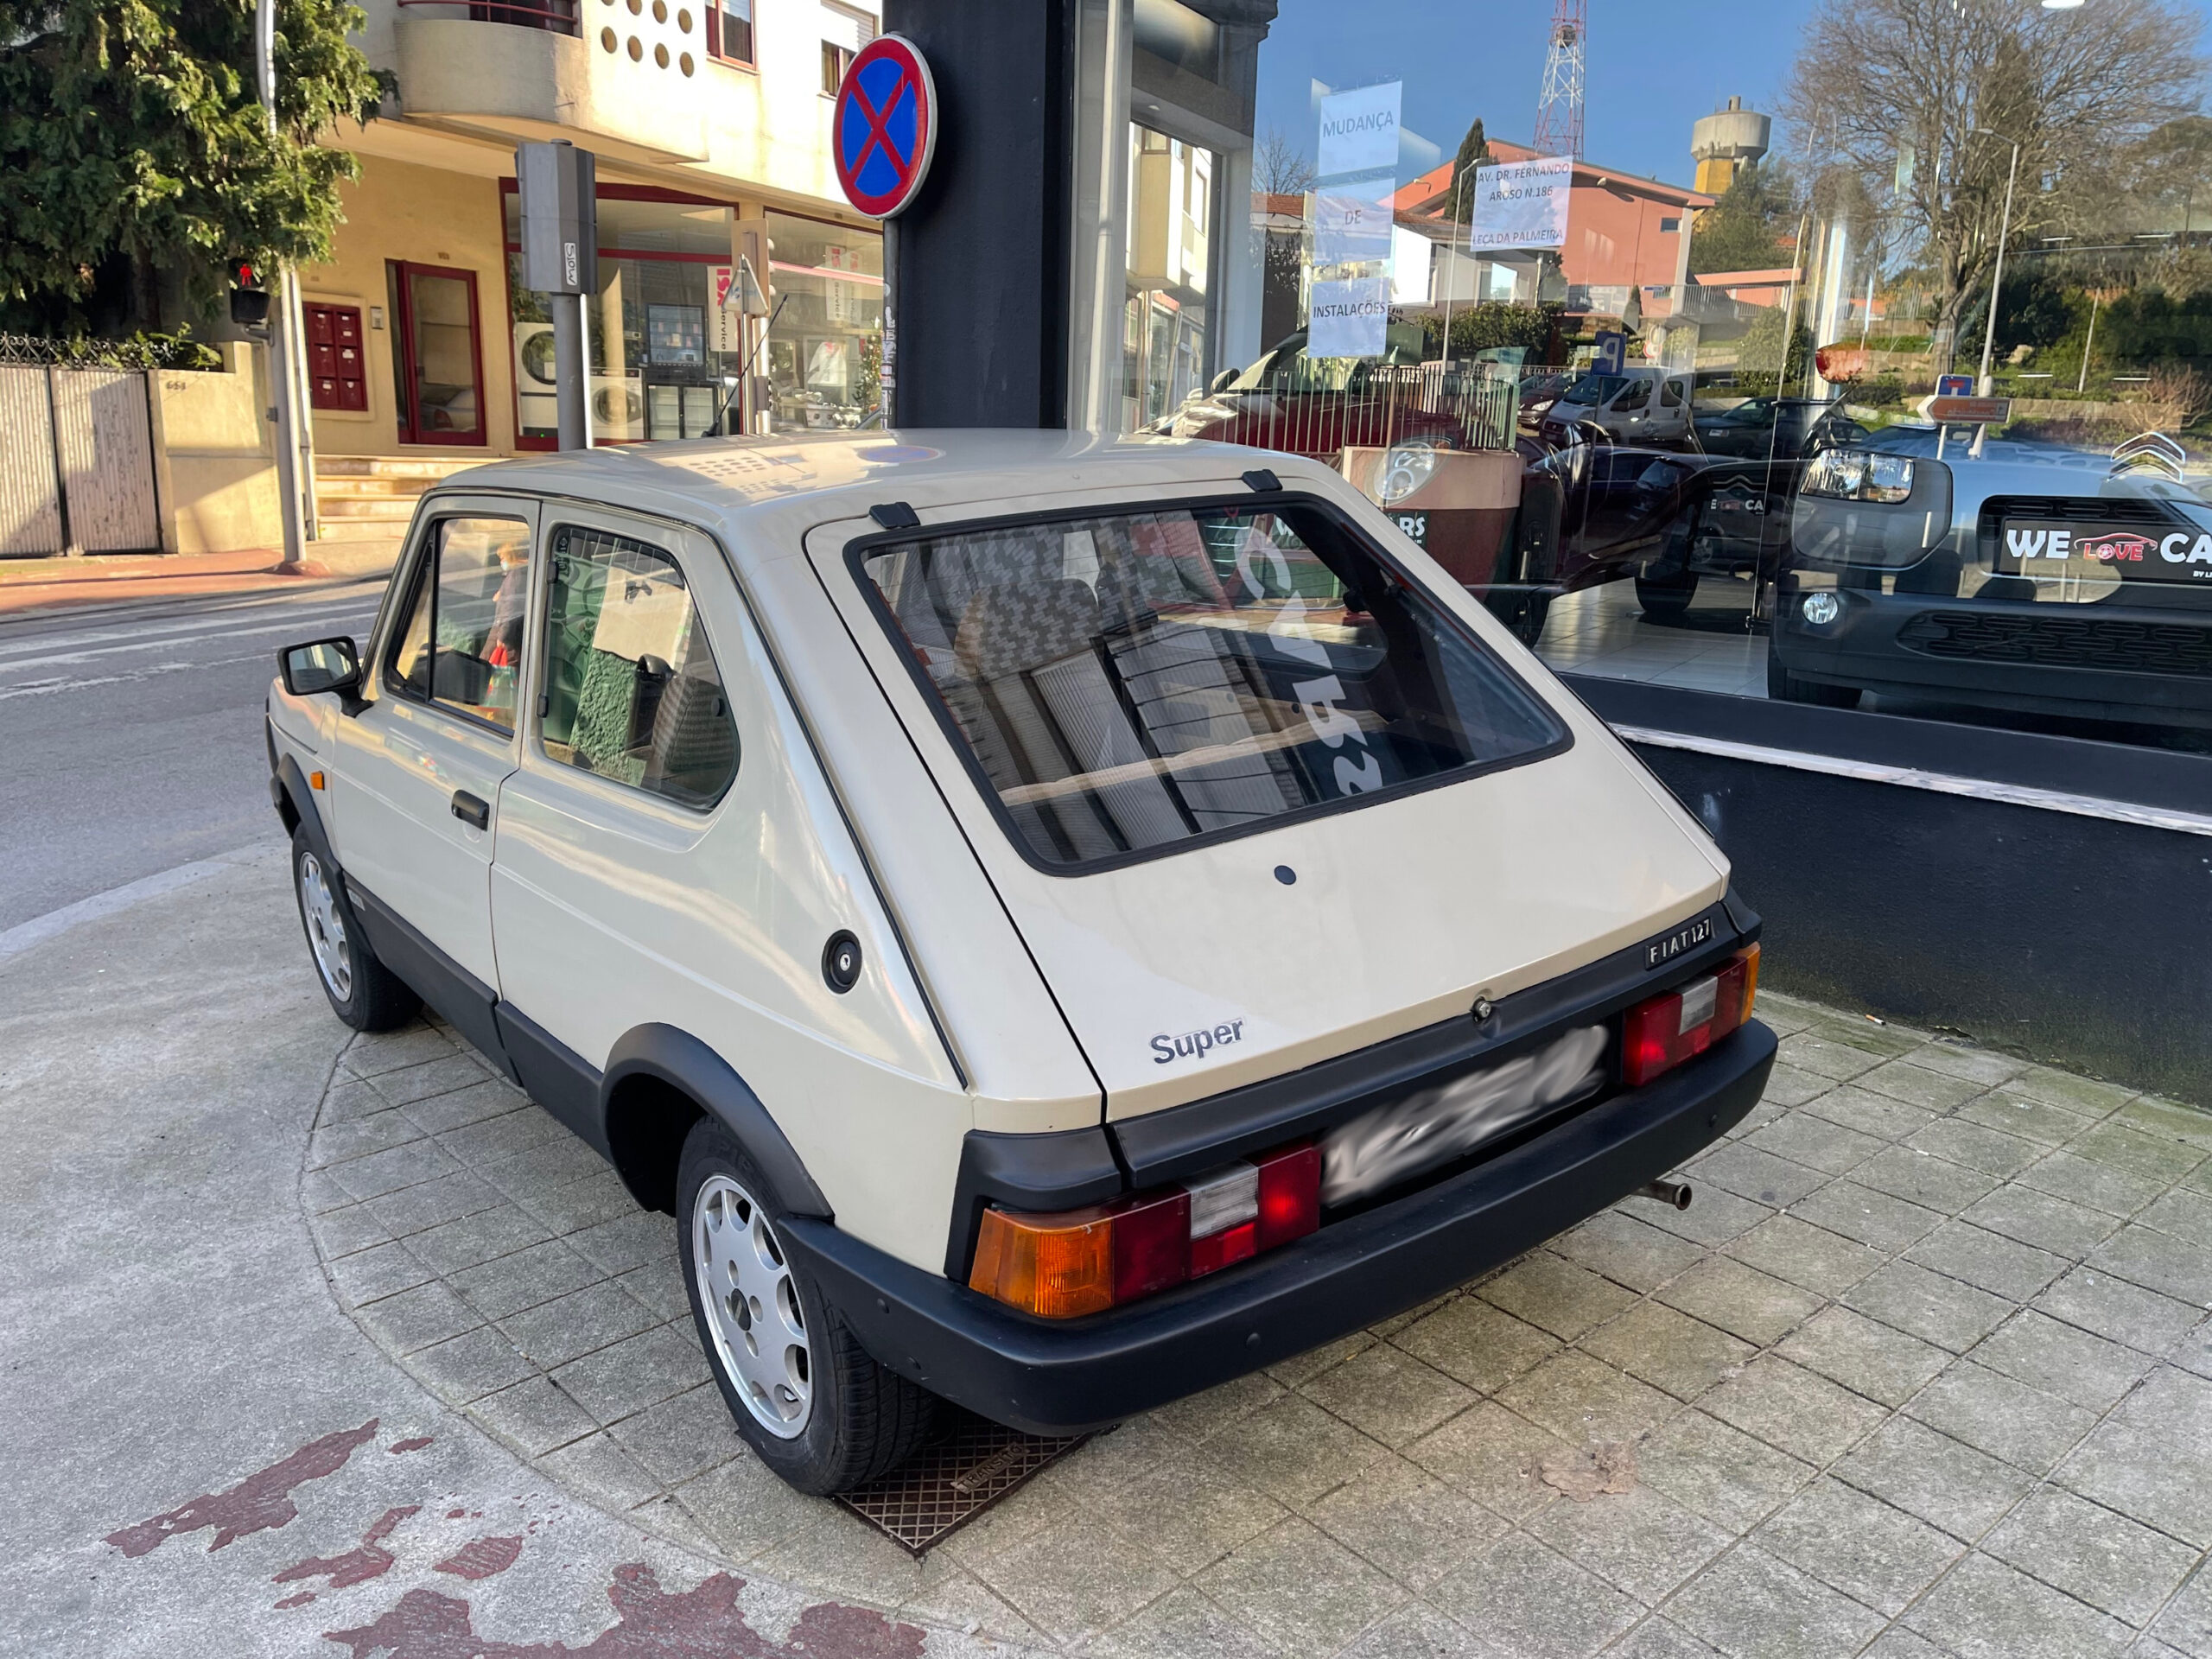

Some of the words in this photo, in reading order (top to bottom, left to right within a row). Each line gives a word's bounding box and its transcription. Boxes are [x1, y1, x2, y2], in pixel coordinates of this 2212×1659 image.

[1323, 111, 1394, 138] MUDANÇA
[1478, 172, 1494, 183] AV.
[1496, 169, 1512, 181] DR.
[1515, 163, 1570, 179] FERNANDO
[1489, 189, 1522, 201] AROSO
[1524, 186, 1553, 199] N.186
[1344, 209, 1362, 226] DE
[1497, 233, 1510, 243] DA
[1512, 229, 1563, 242] PALMEIRA
[1313, 300, 1386, 319] INSTALAÇÕES
[2006, 530, 2071, 559] WE
[2083, 542, 2144, 561] LOVE
[1650, 931, 1688, 963] FIAT
[1691, 918, 1710, 943] 127
[1150, 1020, 1243, 1065] Super
